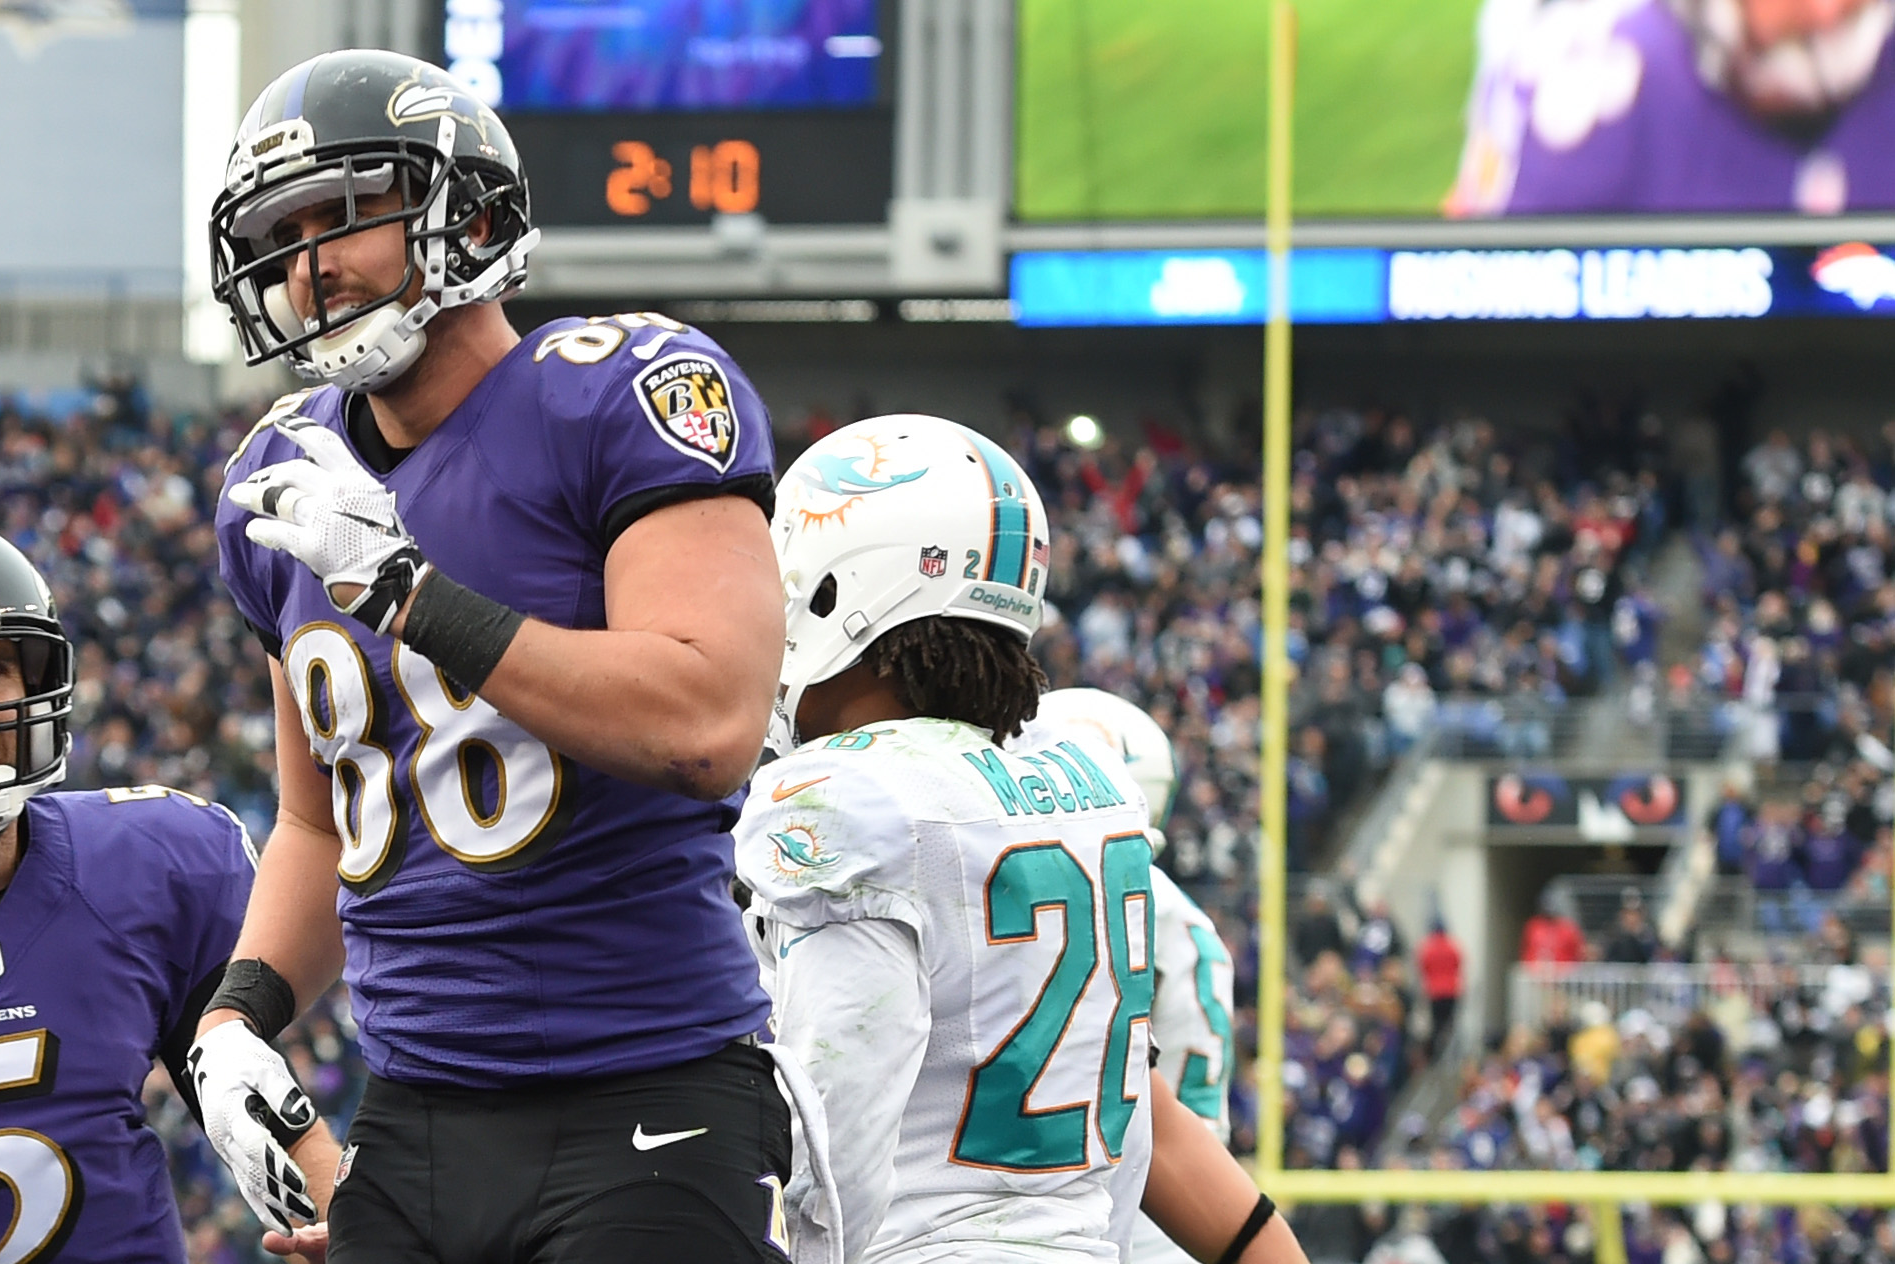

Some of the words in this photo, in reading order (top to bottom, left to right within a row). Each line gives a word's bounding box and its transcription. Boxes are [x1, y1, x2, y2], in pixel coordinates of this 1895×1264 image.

[606, 140, 760, 216] 2:10
[646, 362, 713, 391] RAVENS
[922, 558, 944, 575] NFL
[963, 549, 981, 579] 2
[969, 587, 1033, 615] Dolphins
[282, 621, 562, 882] 88
[947, 831, 1155, 1174] 28
